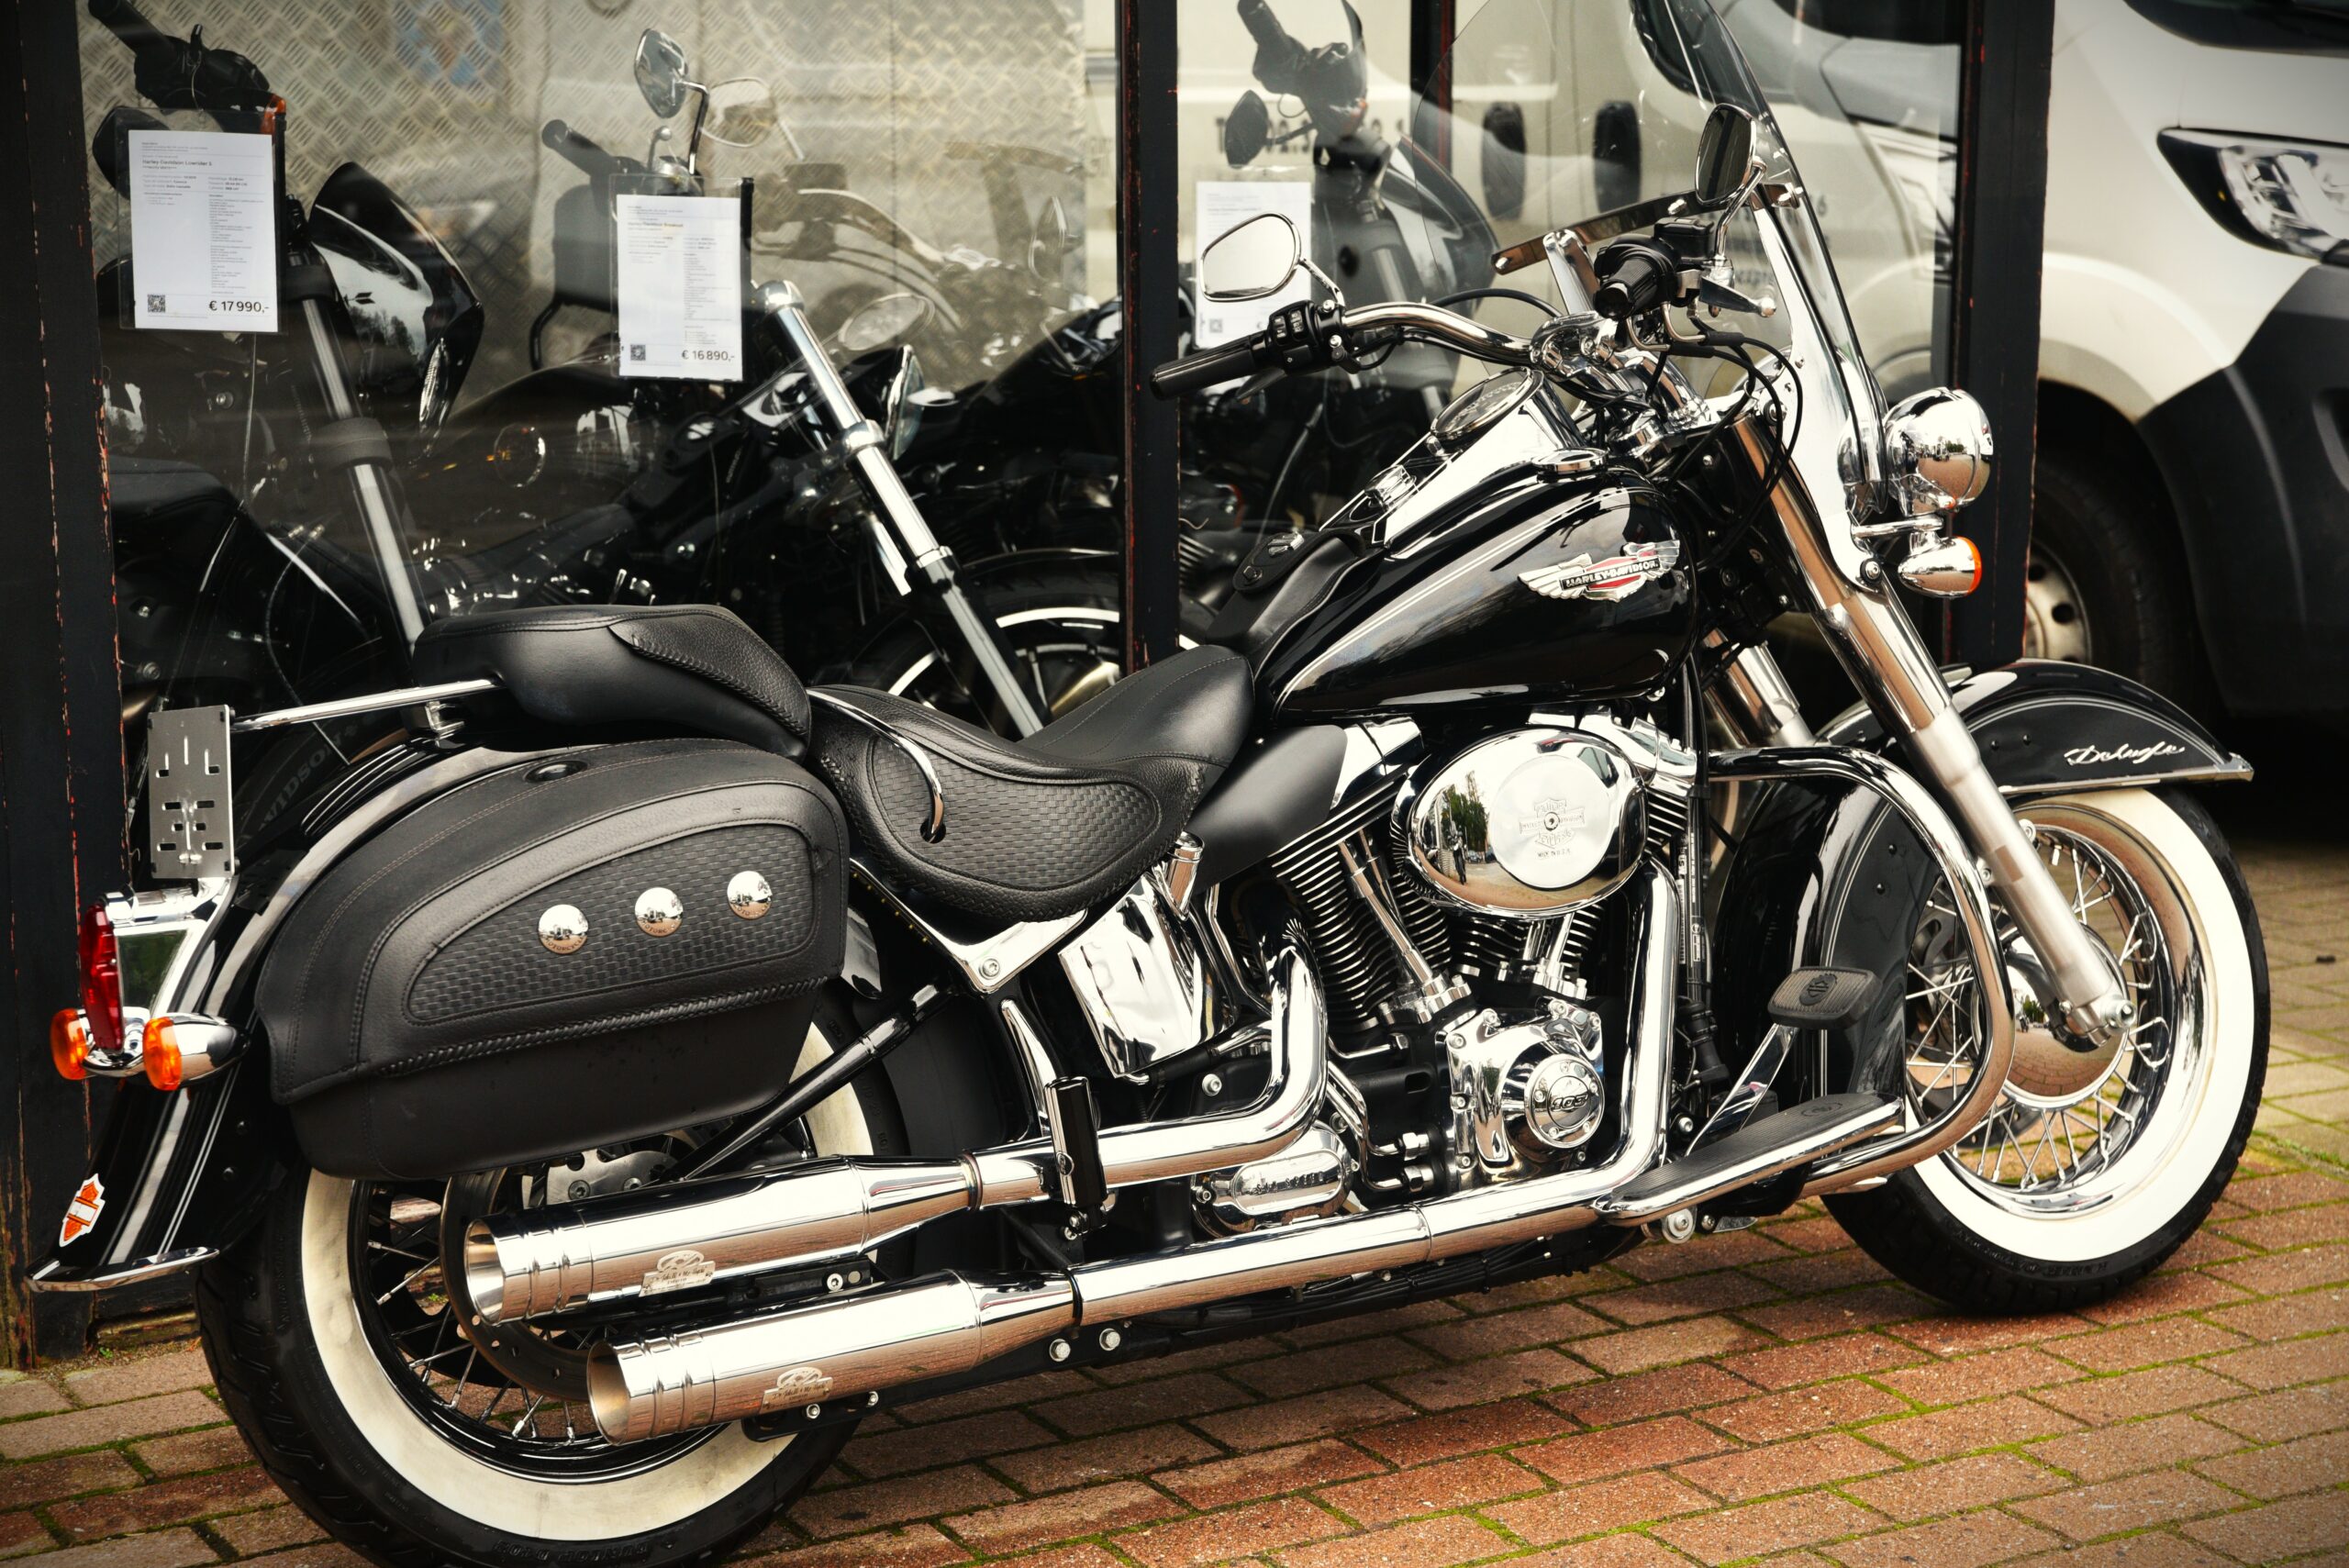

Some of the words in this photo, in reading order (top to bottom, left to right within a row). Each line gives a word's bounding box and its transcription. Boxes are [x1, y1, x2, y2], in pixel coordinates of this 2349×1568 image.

[209, 300, 217, 311] €
[682, 350, 689, 360] €
[1552, 1093, 1589, 1112] 103
